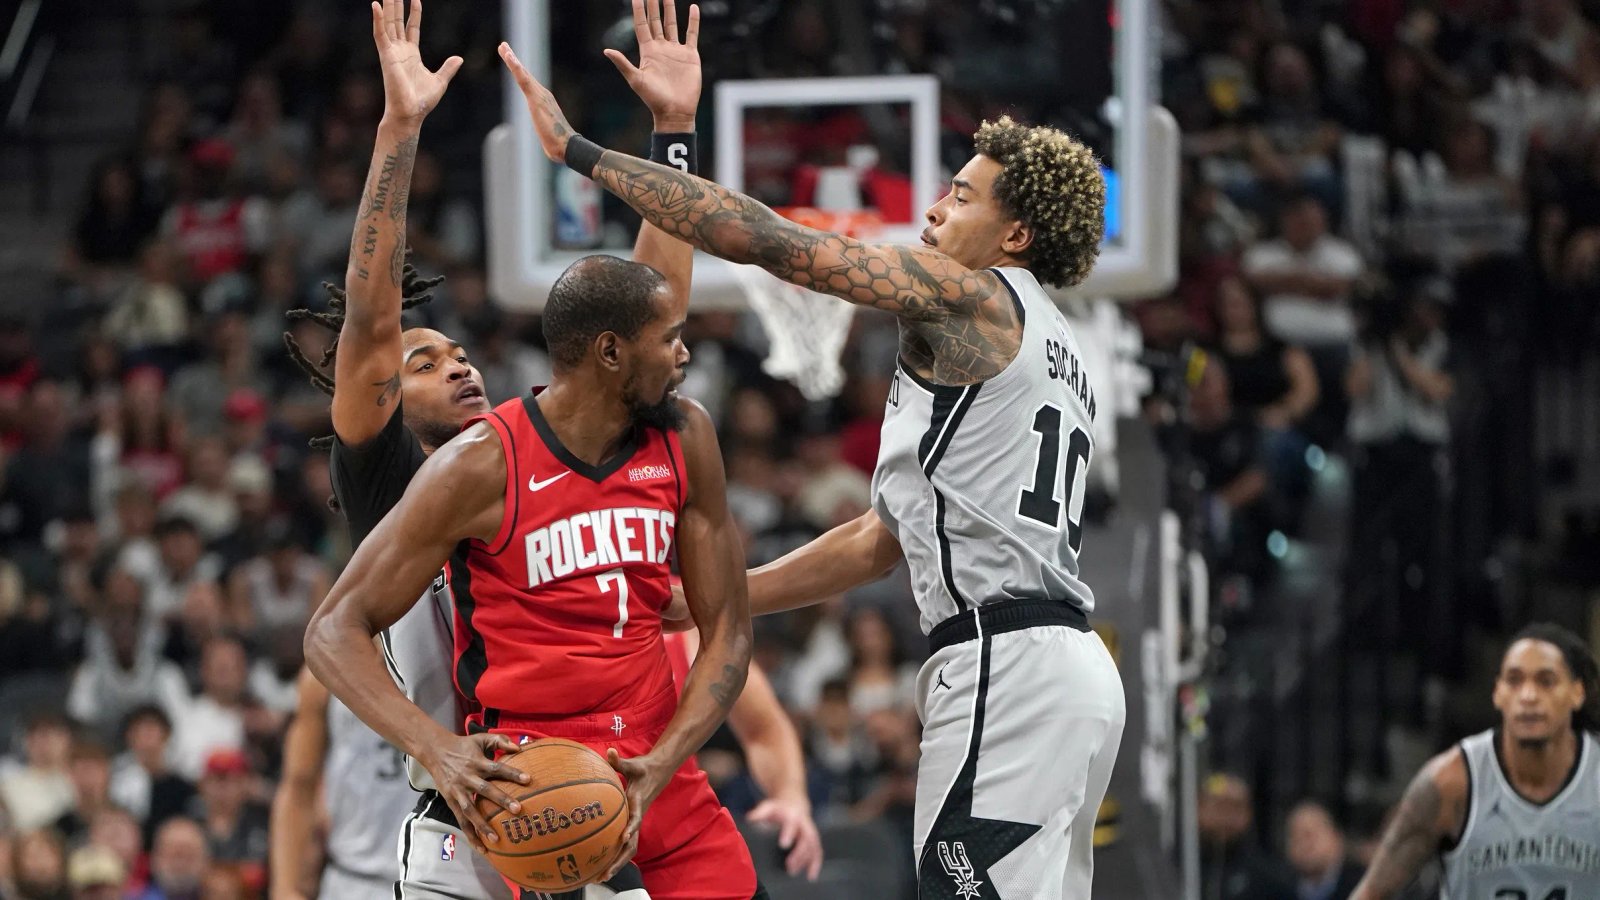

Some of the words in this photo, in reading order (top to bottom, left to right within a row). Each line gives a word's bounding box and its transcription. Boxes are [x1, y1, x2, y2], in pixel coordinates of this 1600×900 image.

[1045, 338, 1097, 425] SOCHAN
[628, 464, 669, 476] MEMORIAL
[629, 468, 671, 482] HERMANN
[1015, 401, 1093, 558] 10
[524, 506, 676, 589] ROCKETS
[595, 567, 629, 639] 7
[501, 800, 605, 845] Wilson
